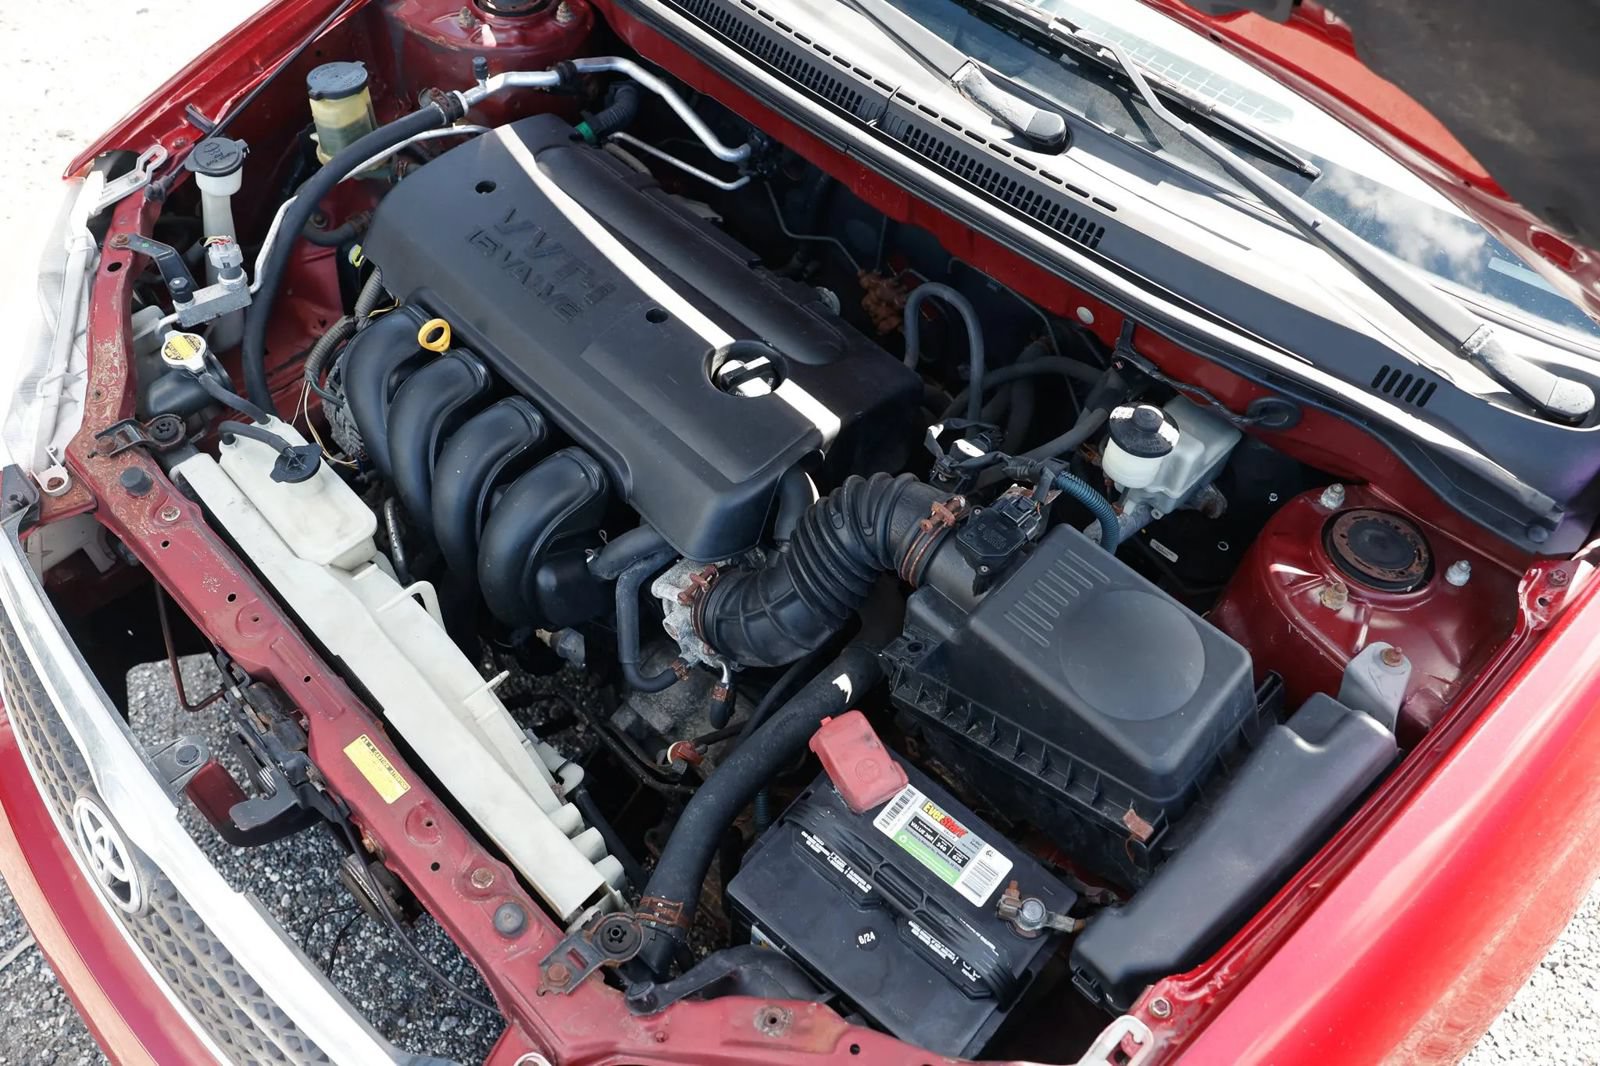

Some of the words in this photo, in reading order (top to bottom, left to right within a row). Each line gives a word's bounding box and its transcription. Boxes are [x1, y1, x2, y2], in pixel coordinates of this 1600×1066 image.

[922, 801, 969, 838] EverStart
[910, 821, 926, 836] VALUE
[858, 931, 876, 945] 6/24
